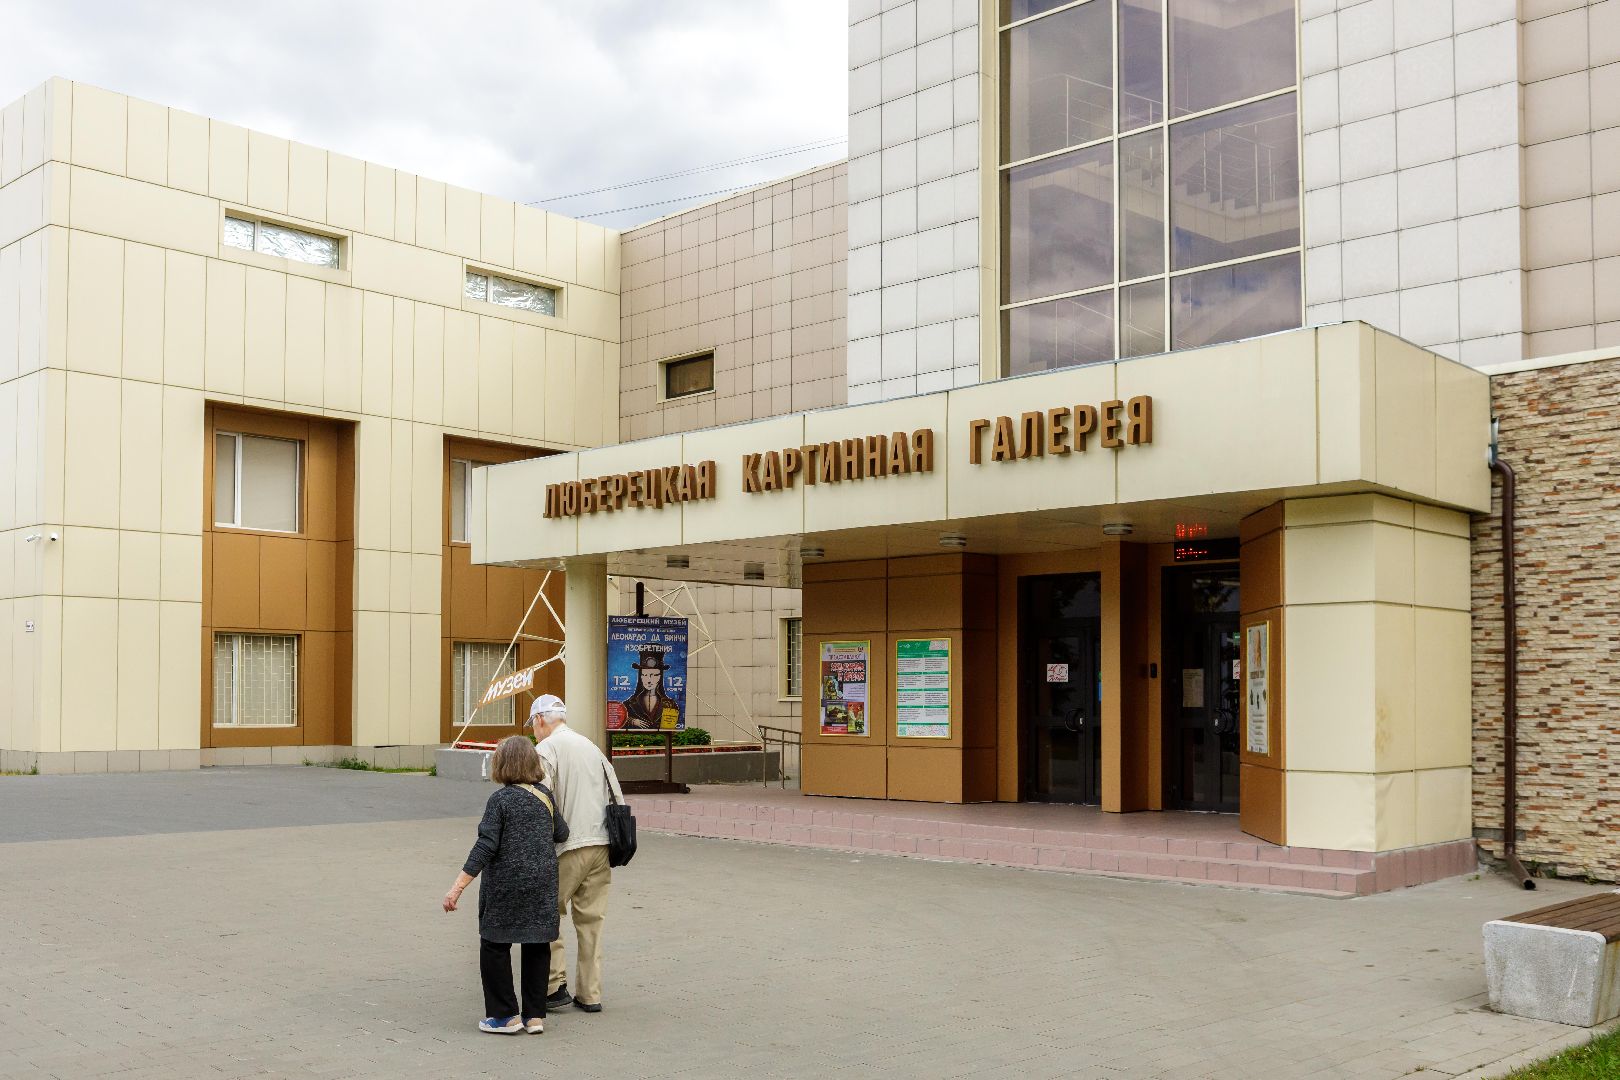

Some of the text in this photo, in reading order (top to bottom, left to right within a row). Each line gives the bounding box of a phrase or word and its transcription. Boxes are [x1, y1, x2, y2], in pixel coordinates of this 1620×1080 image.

[543, 394, 1152, 518] ЛЮБЕРЕЦКАЯ КАРТИННАЯ ГАЛЕРЕЯ
[611, 632, 686, 642] ЛЕОНАРДО ДА ВИНЧИ
[625, 643, 673, 653] ИЗОБРЕТЕНИЯ
[613, 675, 631, 686] 12
[667, 676, 684, 687] 12
